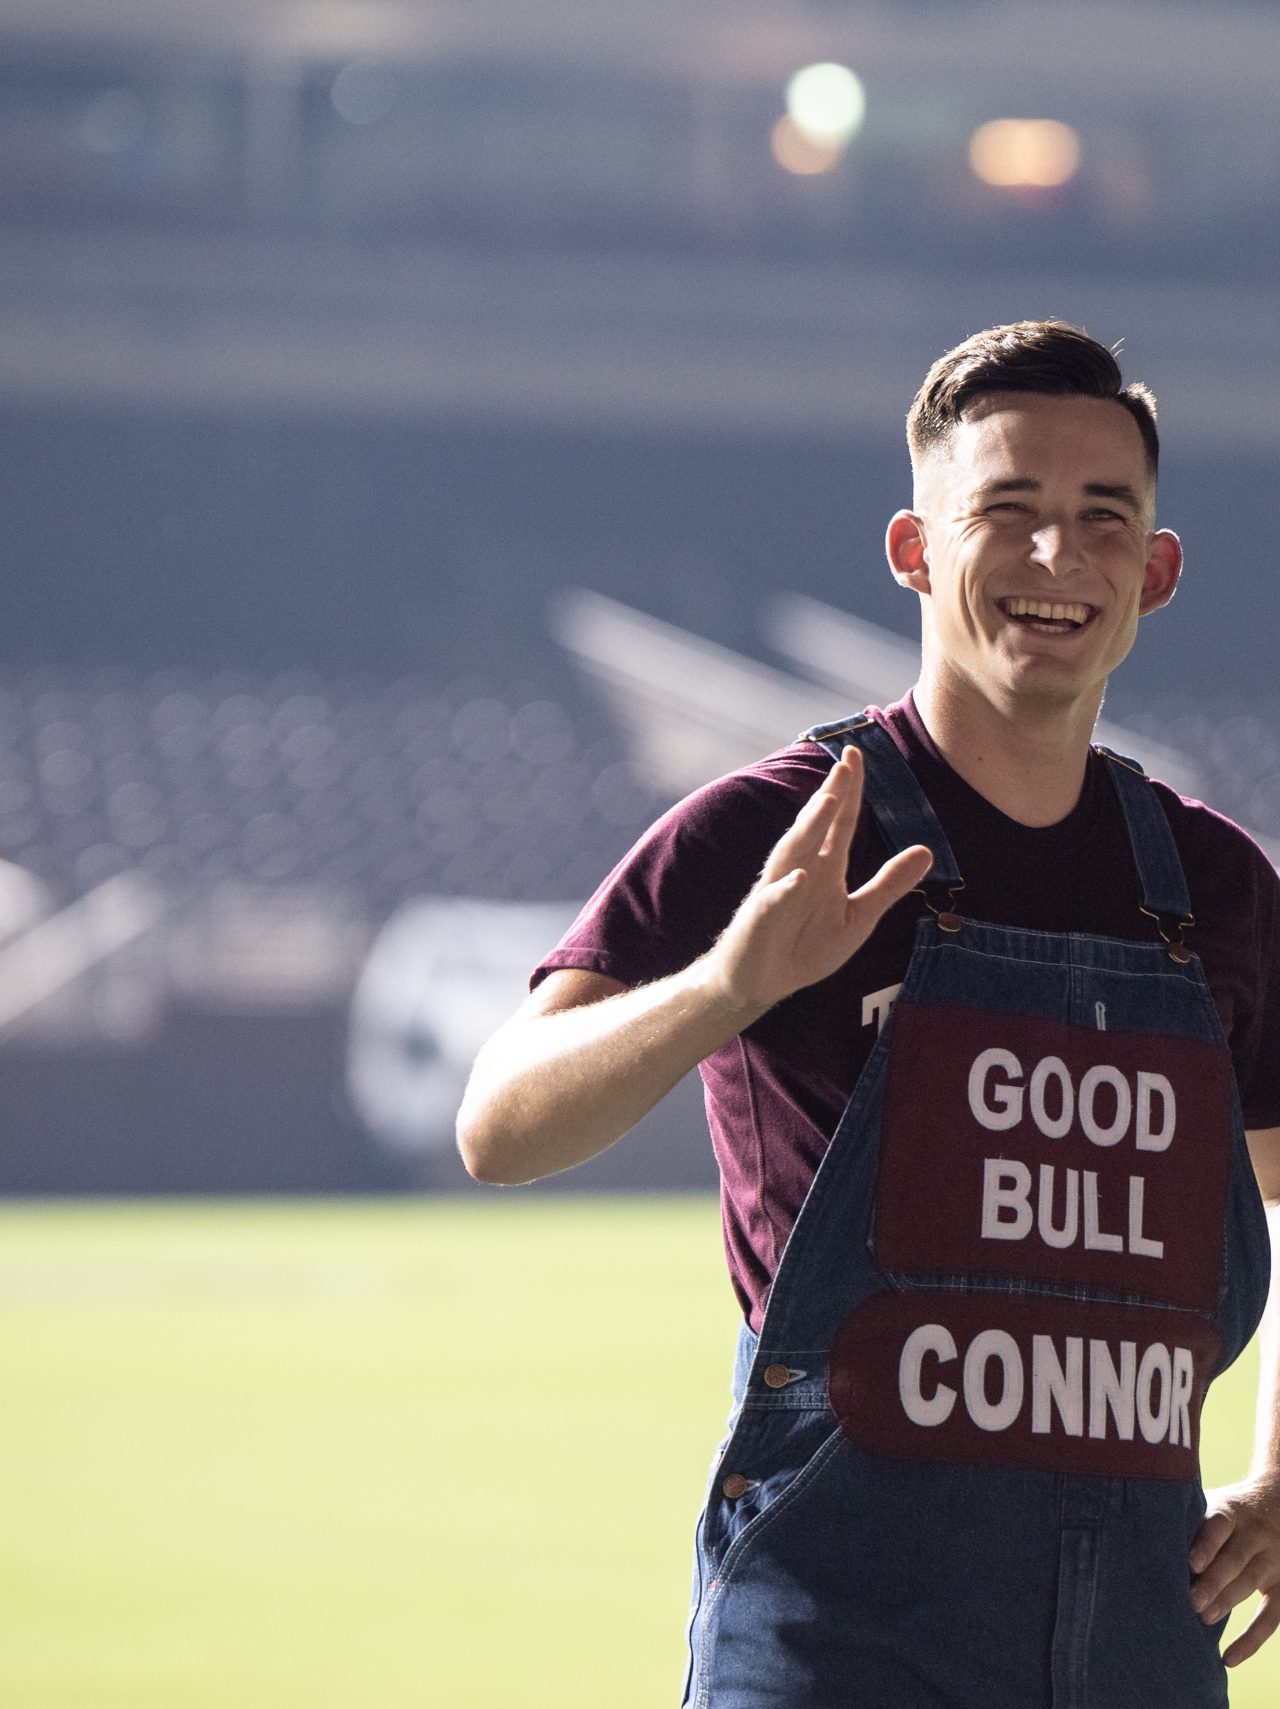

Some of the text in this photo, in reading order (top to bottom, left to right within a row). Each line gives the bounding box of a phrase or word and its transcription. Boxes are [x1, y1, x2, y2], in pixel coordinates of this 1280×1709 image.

[968, 1047, 1177, 1152] GOOD
[981, 1159, 1165, 1259] BULL
[899, 1323, 1194, 1448] CONNOR
